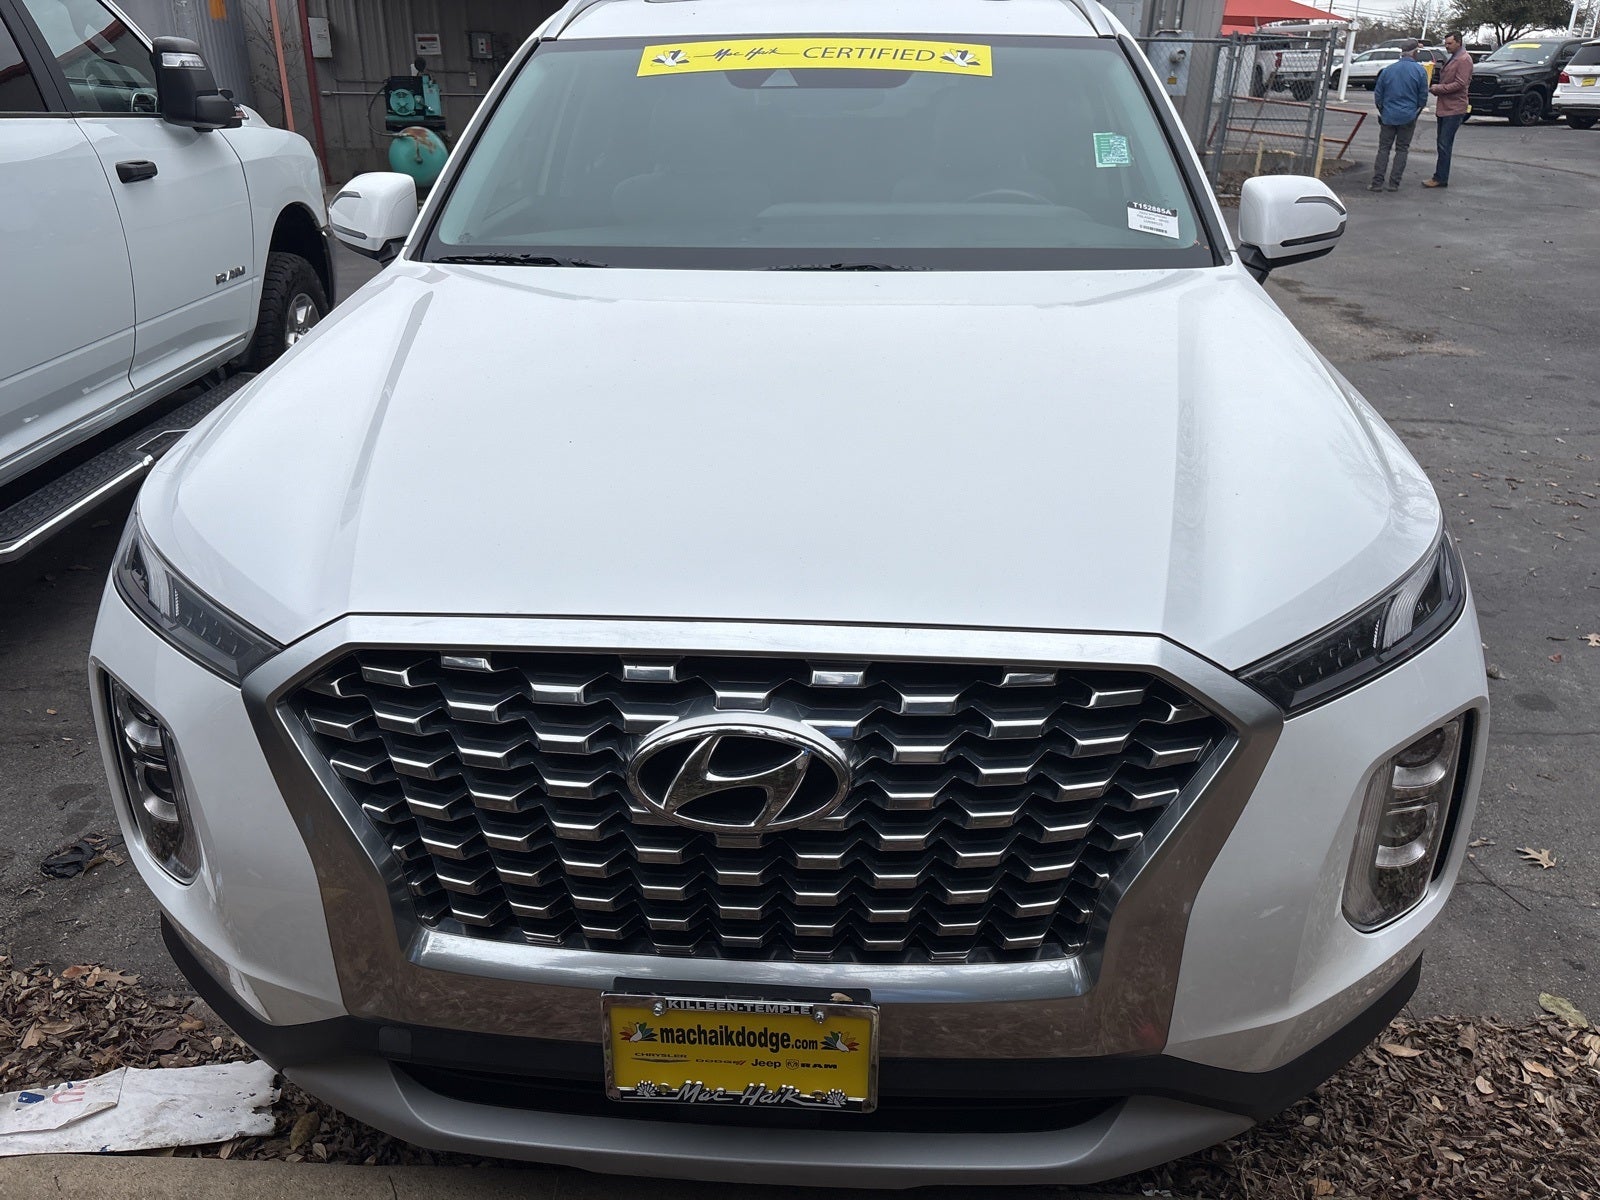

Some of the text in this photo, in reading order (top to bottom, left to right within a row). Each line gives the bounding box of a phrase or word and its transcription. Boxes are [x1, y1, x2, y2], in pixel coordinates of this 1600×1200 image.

[802, 46, 936, 62] CERTIFIED
[667, 1000, 811, 1015] KILLEEN-TEMPLE
[659, 1024, 818, 1053] machaikdodge.com
[751, 1058, 782, 1069] Jeep
[677, 1080, 806, 1106] Mac Haik
